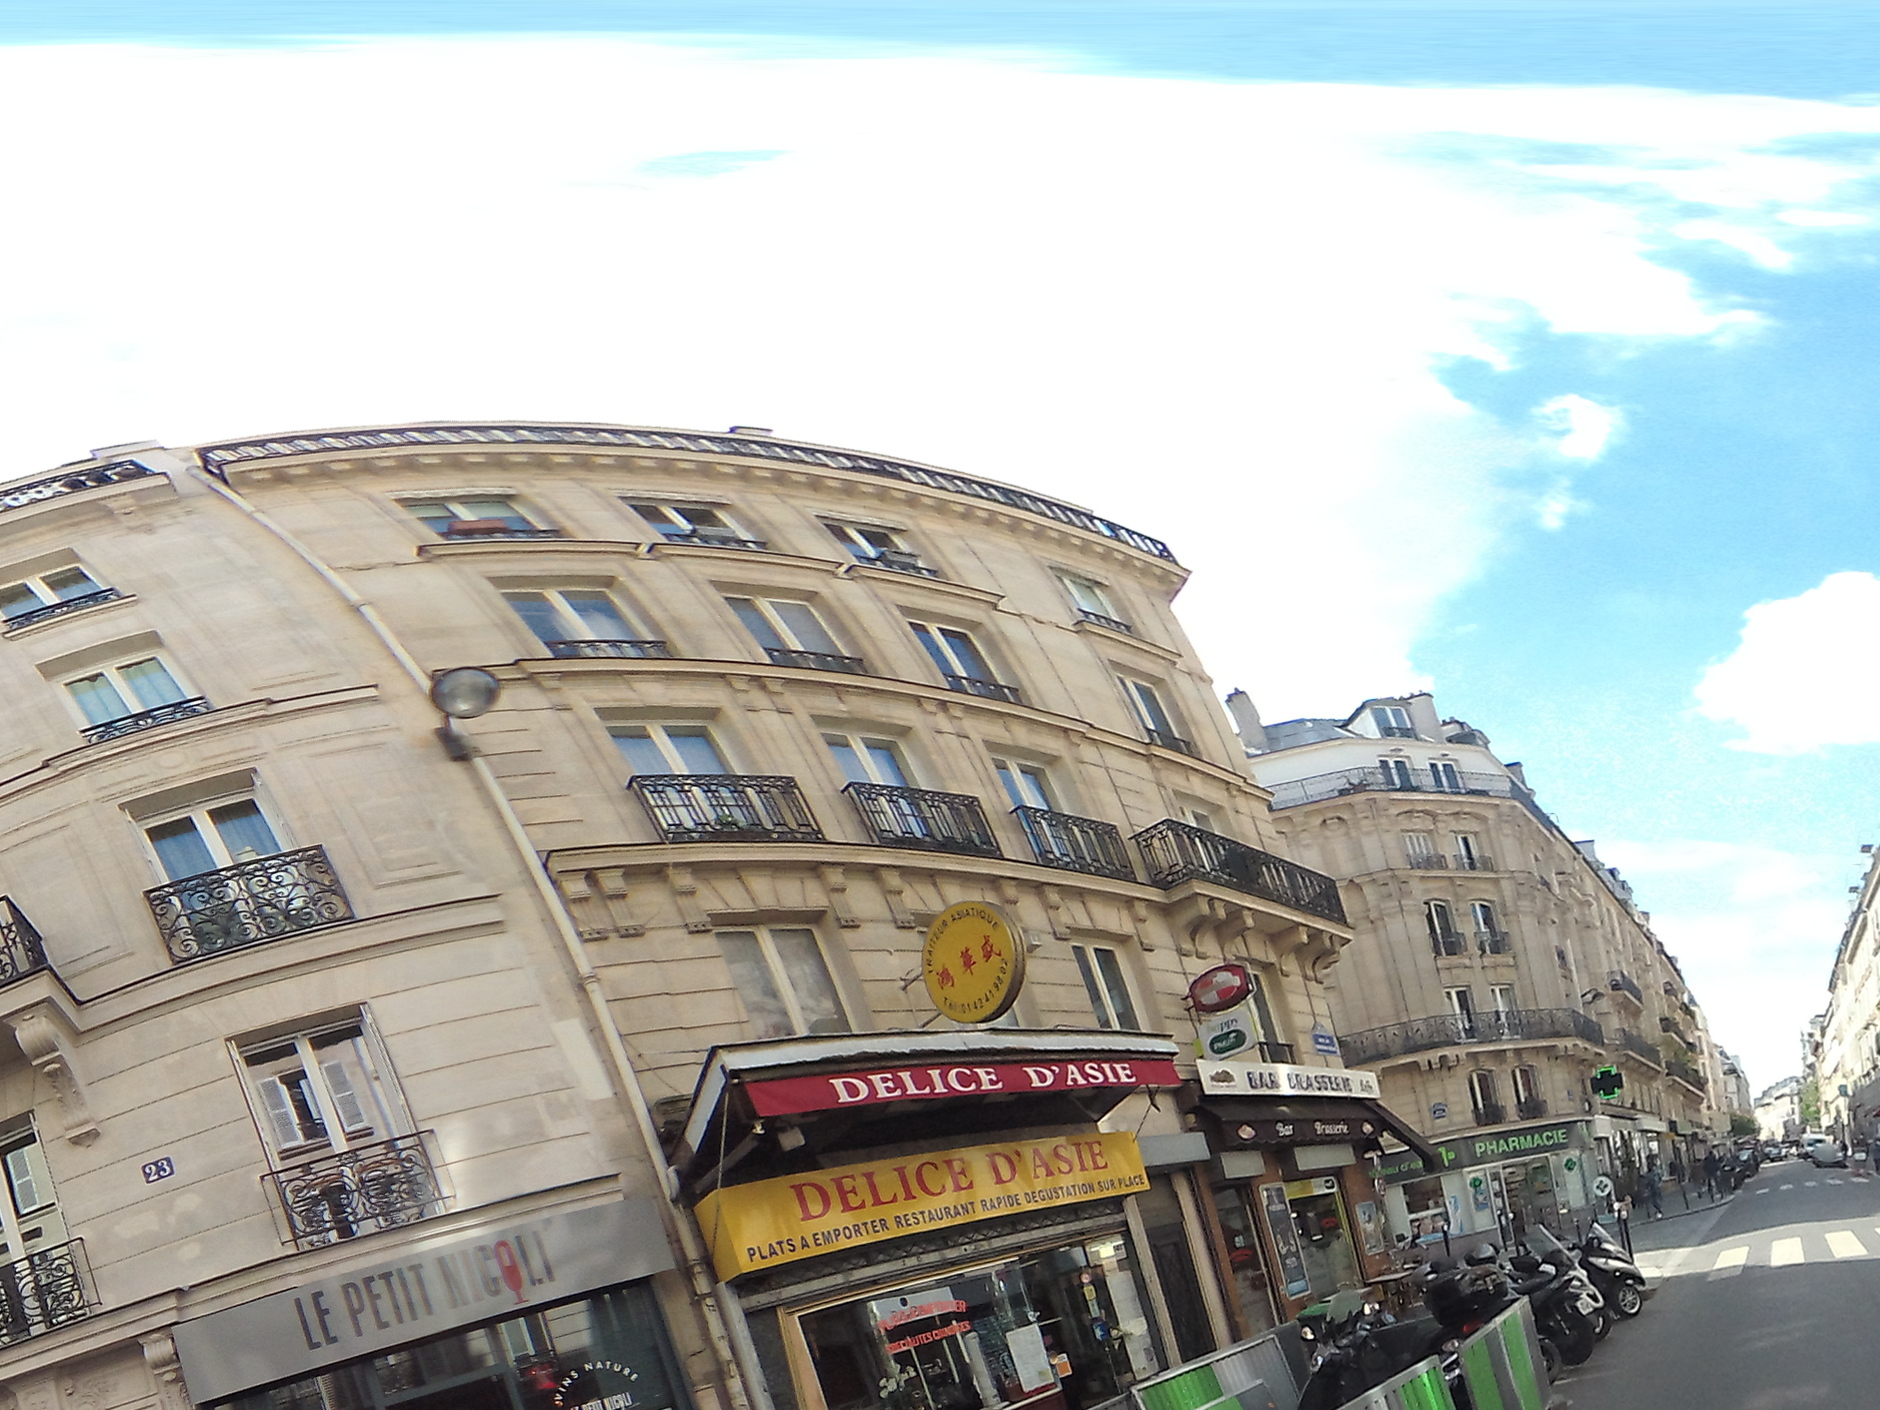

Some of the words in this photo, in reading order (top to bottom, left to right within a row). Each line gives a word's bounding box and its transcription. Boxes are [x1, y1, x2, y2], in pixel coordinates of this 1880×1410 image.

[829, 1067, 1004, 1104] DELICE
[1022, 1061, 1137, 1089] D'ASIE
[1474, 1128, 1569, 1159] PHARMACIE
[145, 1160, 171, 1182] 23
[788, 1156, 974, 1223] DELICE
[987, 1139, 1109, 1186] D'ASIE
[746, 1237, 797, 1263] PLATS
[799, 1235, 810, 1250] A
[812, 1217, 891, 1248] EMPORTER
[894, 1200, 978, 1230] RESTAURANT
[979, 1193, 1022, 1213] RAPIDE
[1023, 1182, 1096, 1205] DEGUSTATION
[1096, 1179, 1117, 1193] SUR
[1117, 1174, 1146, 1189] PLACE
[293, 1290, 339, 1351] LE
[341, 1262, 435, 1338] PETIT
[436, 1230, 556, 1306] NICOLI
[554, 1370, 580, 1402] VINS
[583, 1360, 640, 1382] NATURE
